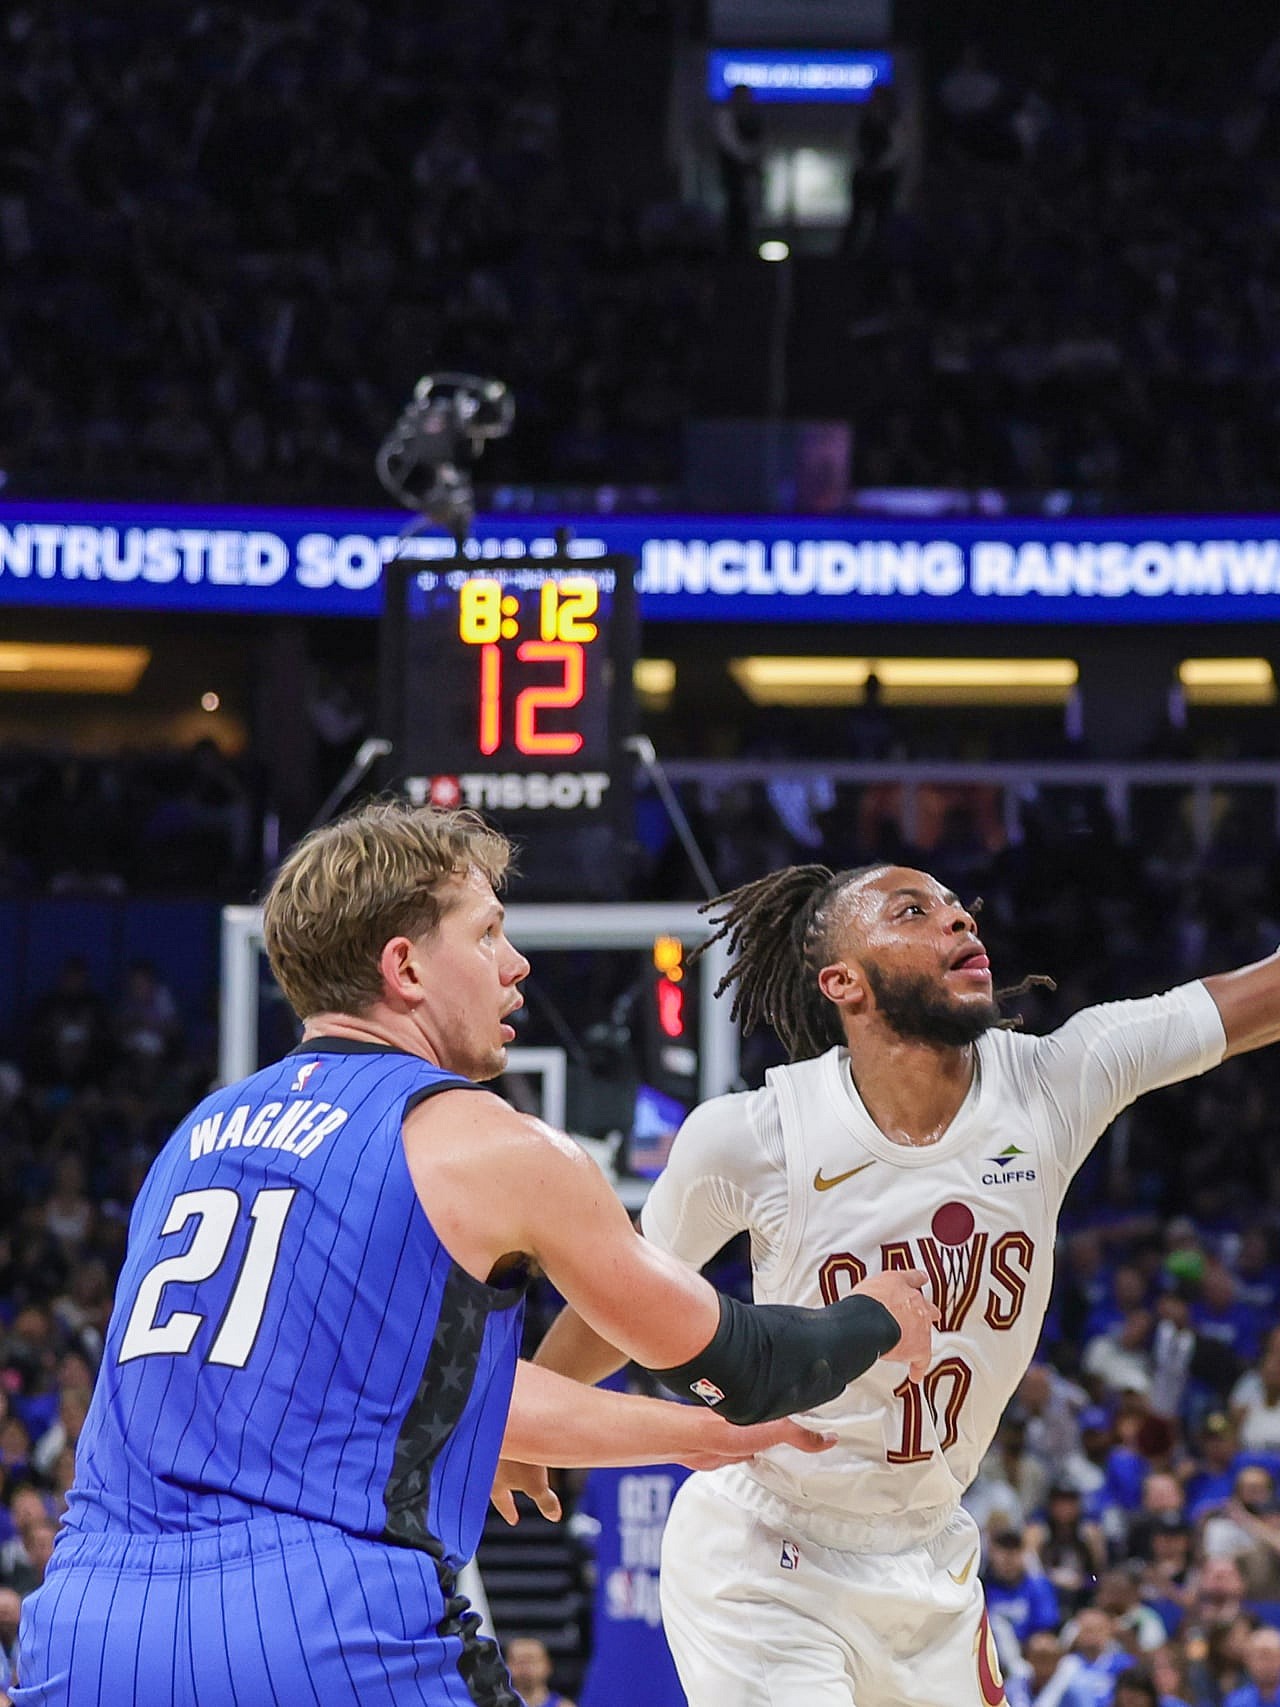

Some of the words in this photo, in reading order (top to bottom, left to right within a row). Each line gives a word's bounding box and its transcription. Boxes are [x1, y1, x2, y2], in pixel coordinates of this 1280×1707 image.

[459, 576, 599, 645] 8:12
[478, 641, 585, 756] 12
[459, 772, 610, 810] TISSOT
[188, 1100, 348, 1161] WAGNER
[982, 1170, 1036, 1186] CLIFFS
[117, 1186, 299, 1369] 21
[887, 1356, 972, 1465] 10
